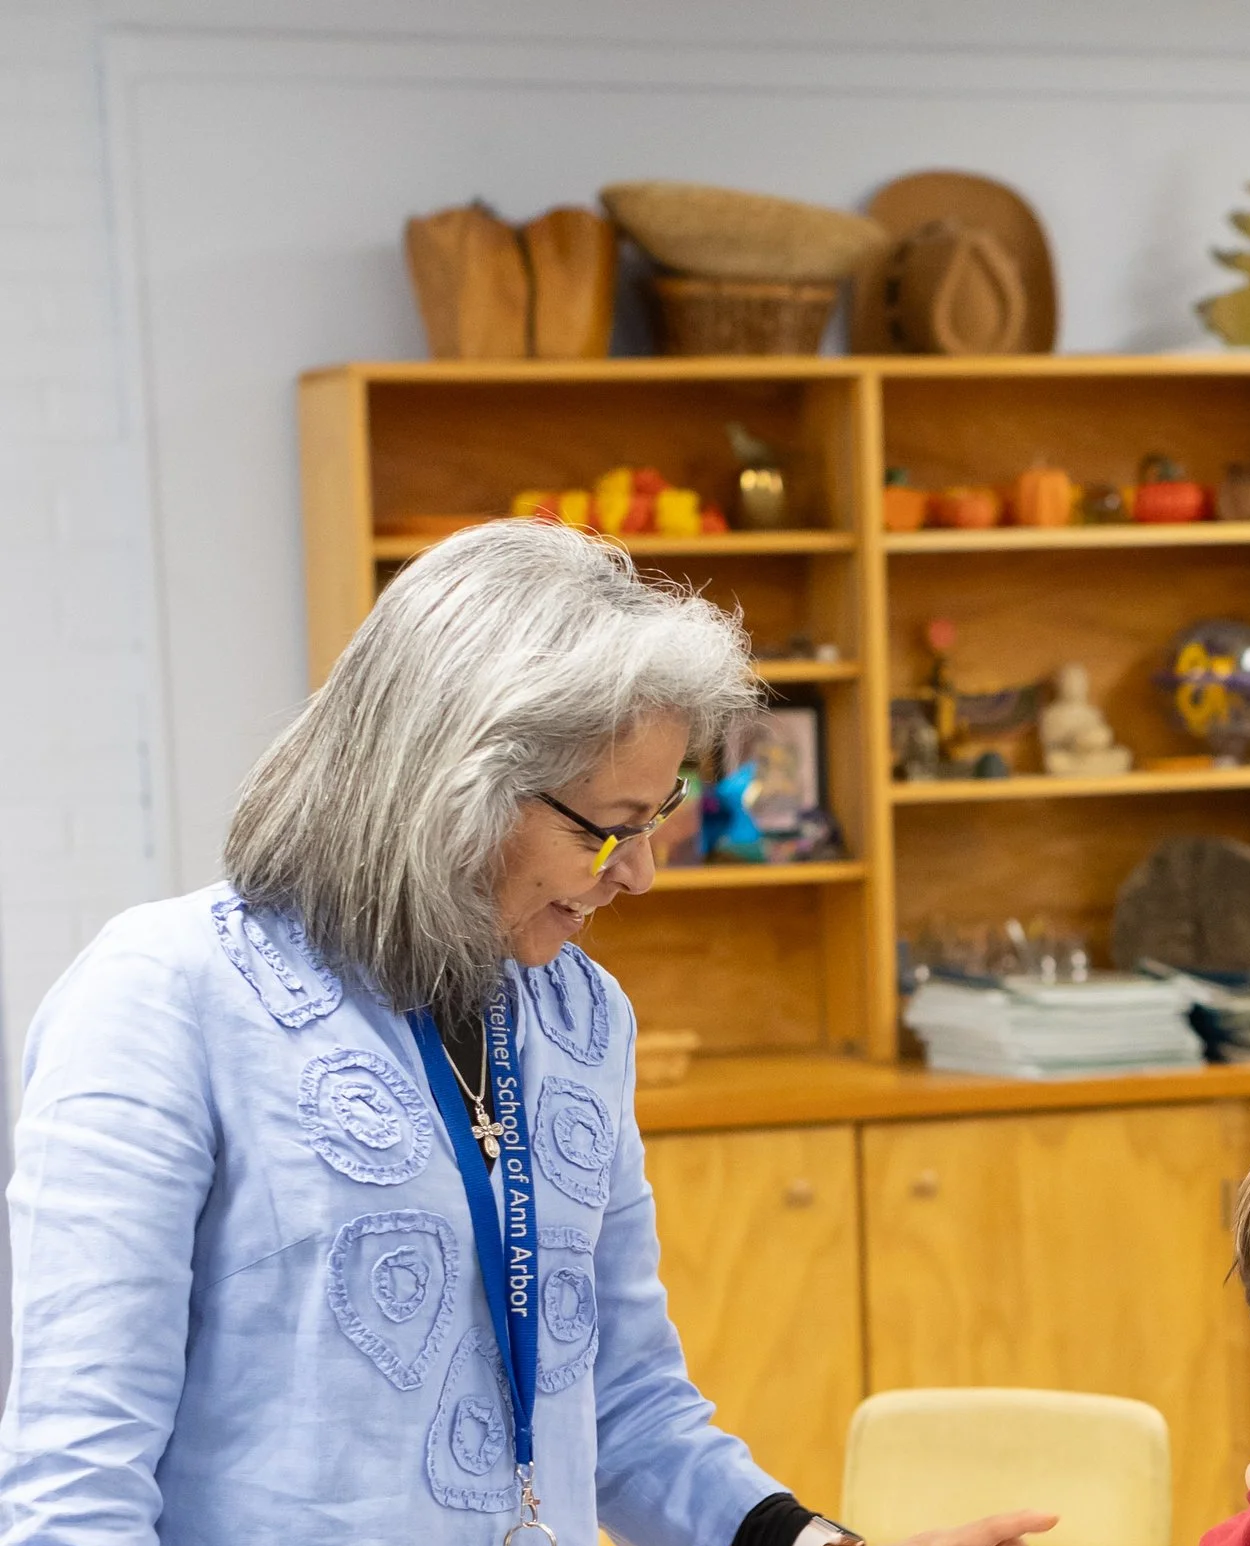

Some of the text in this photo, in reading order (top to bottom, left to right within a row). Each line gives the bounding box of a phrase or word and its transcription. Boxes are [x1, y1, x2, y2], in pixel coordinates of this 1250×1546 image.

[490, 993, 510, 1070] Steiner
[498, 1078, 526, 1150] School
[507, 1160, 529, 1183] of
[510, 1190, 529, 1237] Ann
[510, 1247, 533, 1317] Arbor
